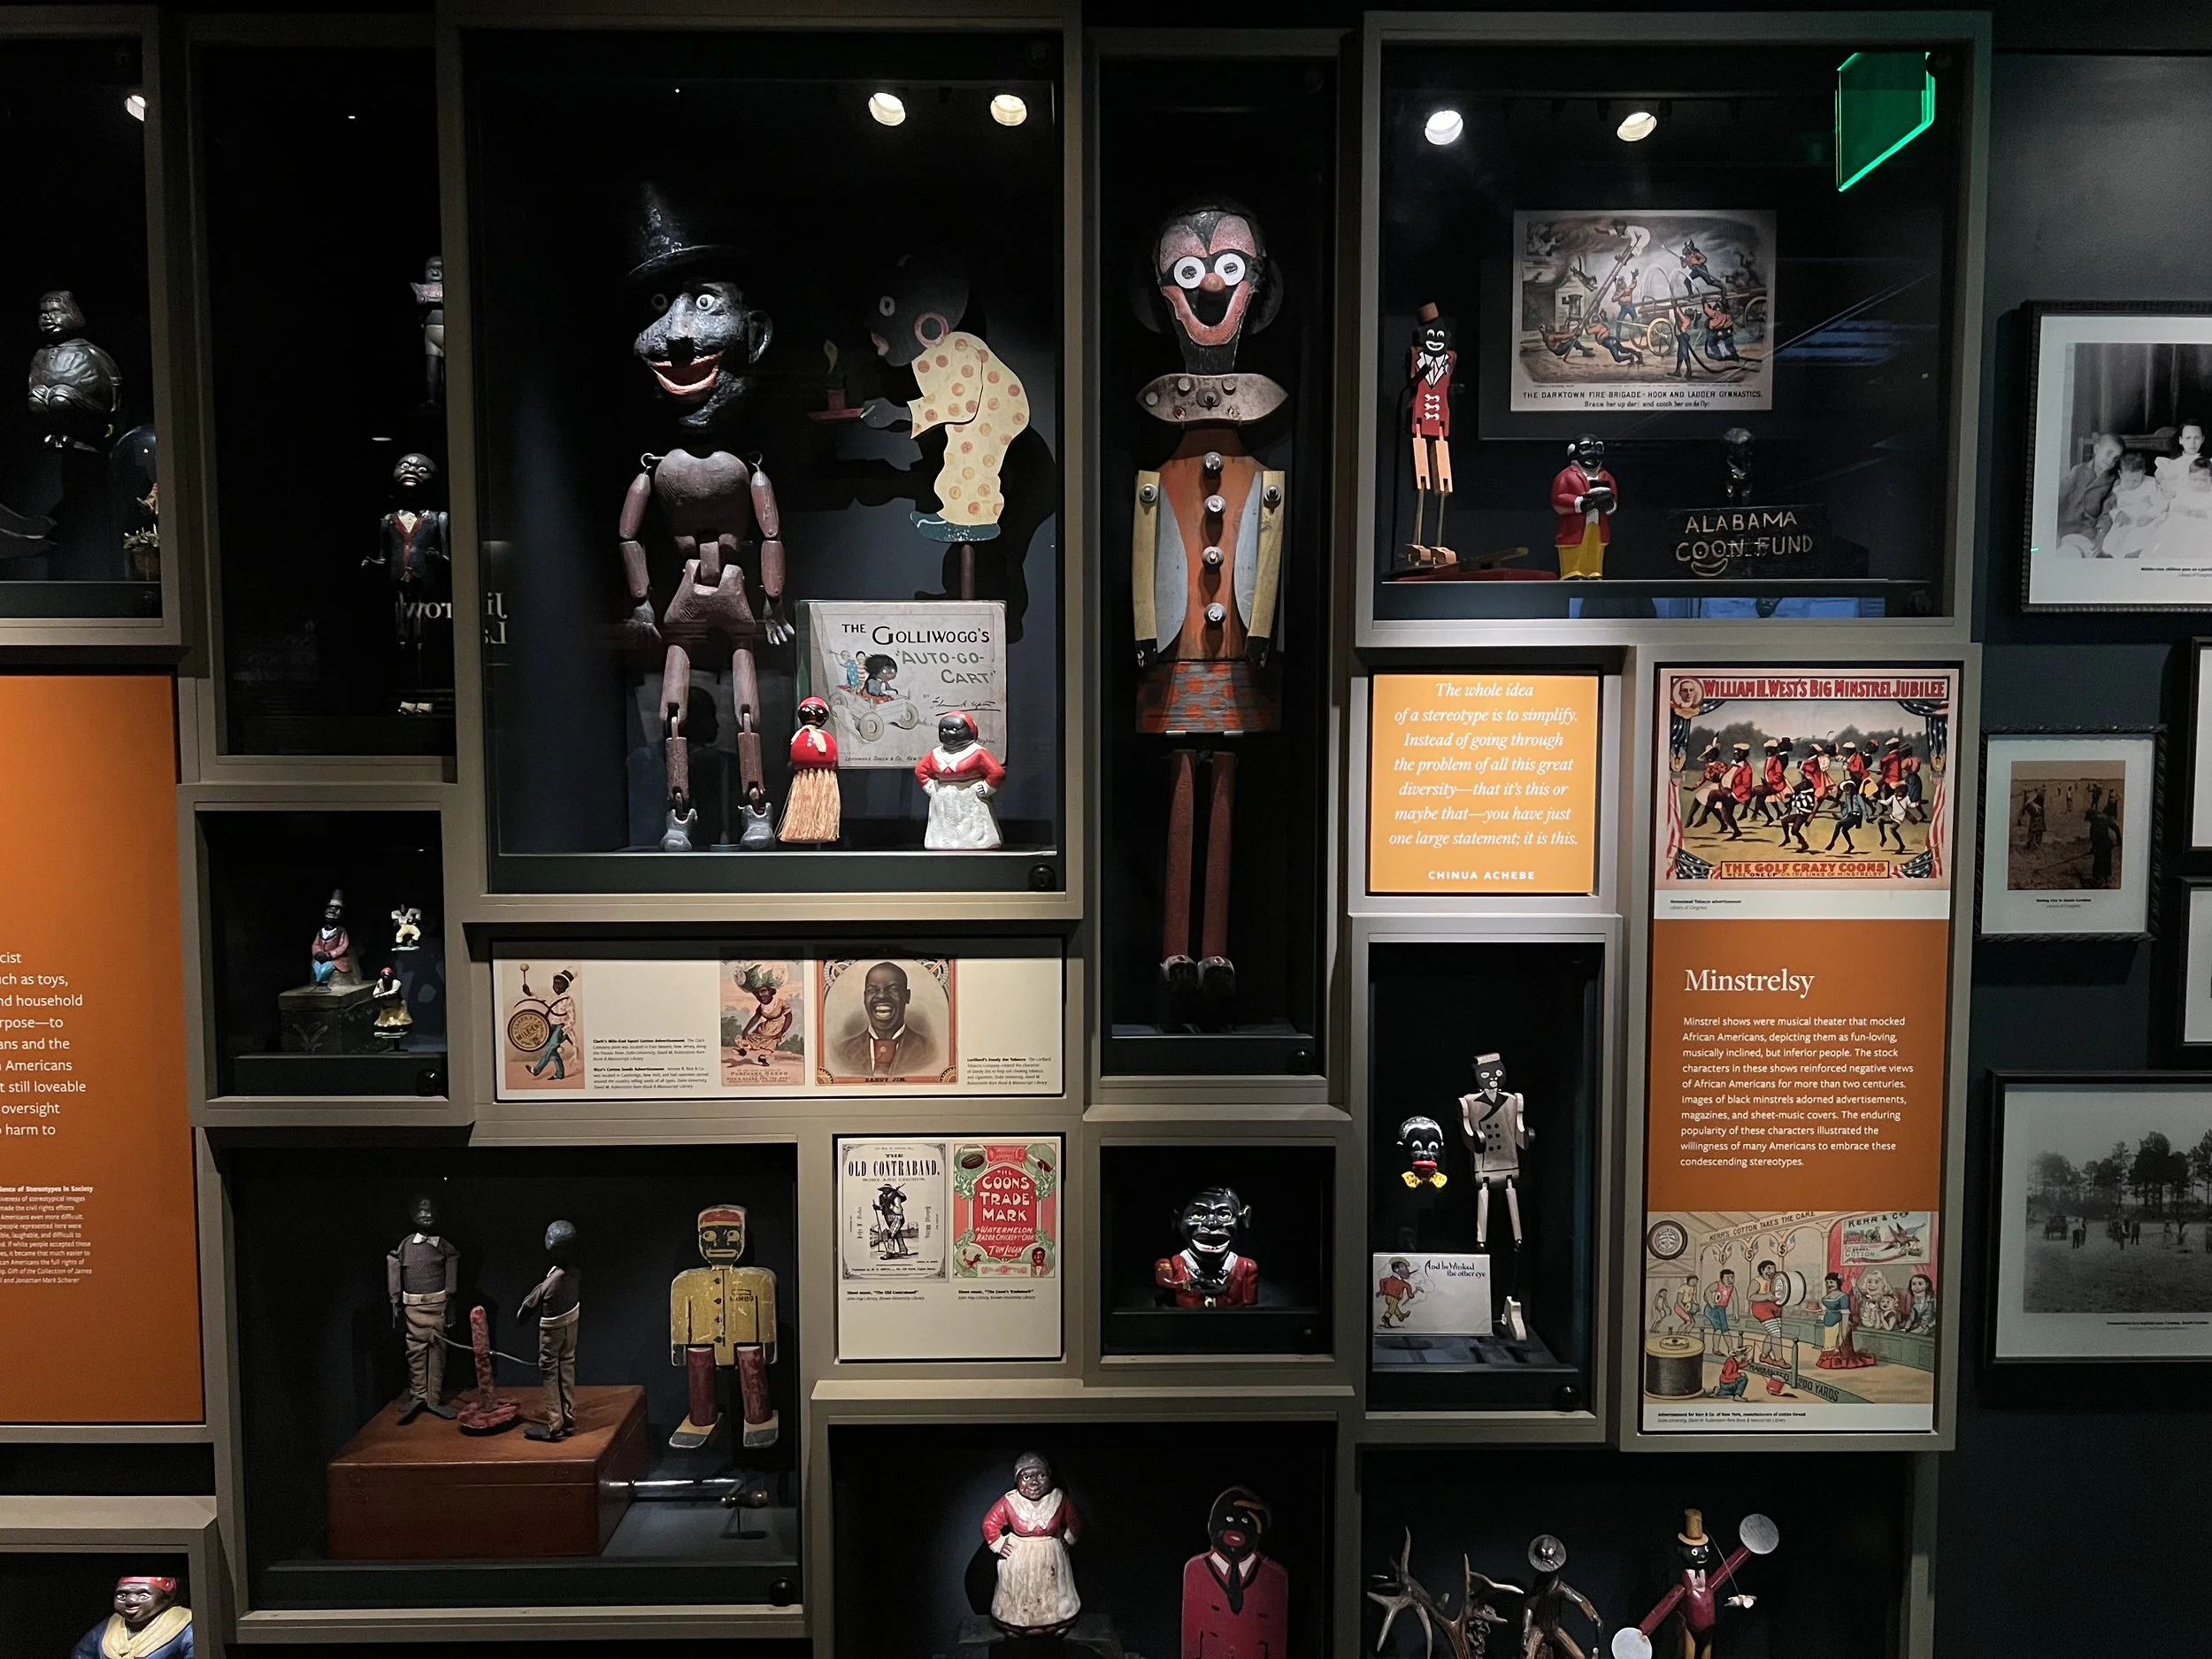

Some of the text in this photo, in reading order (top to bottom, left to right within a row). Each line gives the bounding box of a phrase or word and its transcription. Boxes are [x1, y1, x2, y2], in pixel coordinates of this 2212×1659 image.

[1685, 511, 1797, 534] ALABAMA
[1676, 534, 1813, 562] COON FUND
[841, 623, 990, 646] THE GOLLIWOGG'S
[1436, 682, 1533, 697] The whole idea
[1703, 680, 1755, 697] WILLIAM
[1768, 679, 1808, 697] WEST'S
[1809, 680, 1832, 697] BIG
[1834, 680, 1892, 697] MINSTREL
[1893, 680, 1945, 697] JUBILEE
[1394, 708, 1577, 726] of a stereotype is to simplify.
[1404, 732, 1563, 751] Instead of going through
[1394, 757, 1574, 775] the problem of all this great
[1525, 781, 1550, 795] this
[1552, 786, 1569, 795] or
[1395, 806, 1439, 823] maybe
[1512, 806, 1544, 820] have
[1543, 807, 1571, 824] just
[1389, 831, 1578, 849] one large statement; it is this.
[1724, 863, 1886, 872] THE GOLF CRAZY COONS
[1428, 871, 1534, 879] CHINUA ACHEBE
[20, 976, 35, 985] as
[37, 975, 68, 988] toys,
[1685, 968, 1815, 999] Minstrelsy
[16, 995, 82, 1006] household
[1684, 1017, 1720, 1025] Minstrel
[1723, 1017, 1751, 1025] shows
[1778, 1017, 1811, 1025] musical
[1814, 1017, 1847, 1025] theater
[1848, 1017, 1867, 1025] that
[1870, 1017, 1905, 1025] mocked
[21, 1038, 45, 1049] and
[49, 1038, 70, 1049] the
[1682, 1032, 1715, 1041] African
[1717, 1033, 1767, 1042] Americans,
[1769, 1033, 1811, 1044] depicting
[1813, 1033, 1837, 1041] them
[1851, 1032, 1897, 1044] fun-loving,
[1683, 1048, 1724, 1059] musically
[1726, 1048, 1763, 1058] inclined,
[1766, 1048, 1781, 1057] but
[1784, 1048, 1817, 1057] inferior
[1819, 1048, 1852, 1059] people.
[1855, 1048, 1871, 1057] The
[5, 1059, 73, 1071] Americans
[9, 1080, 30, 1093] still
[35, 1080, 86, 1093] loveable
[1, 1102, 60, 1118] oversight
[5, 1124, 56, 1135] harm to
[849, 1160, 940, 1177] OLD CONTRABAND.
[981, 1176, 1030, 1189] COONS
[982, 1208, 1027, 1222] MARK
[1732, 1225, 1757, 1236] COTTON
[1759, 1219, 1779, 1229] TAKES
[1795, 1211, 1816, 1220] CAKE
[1848, 1217, 1878, 1228] KERR
[1798, 1378, 1813, 1391] 200
[1814, 1383, 1839, 1402] YARDS
